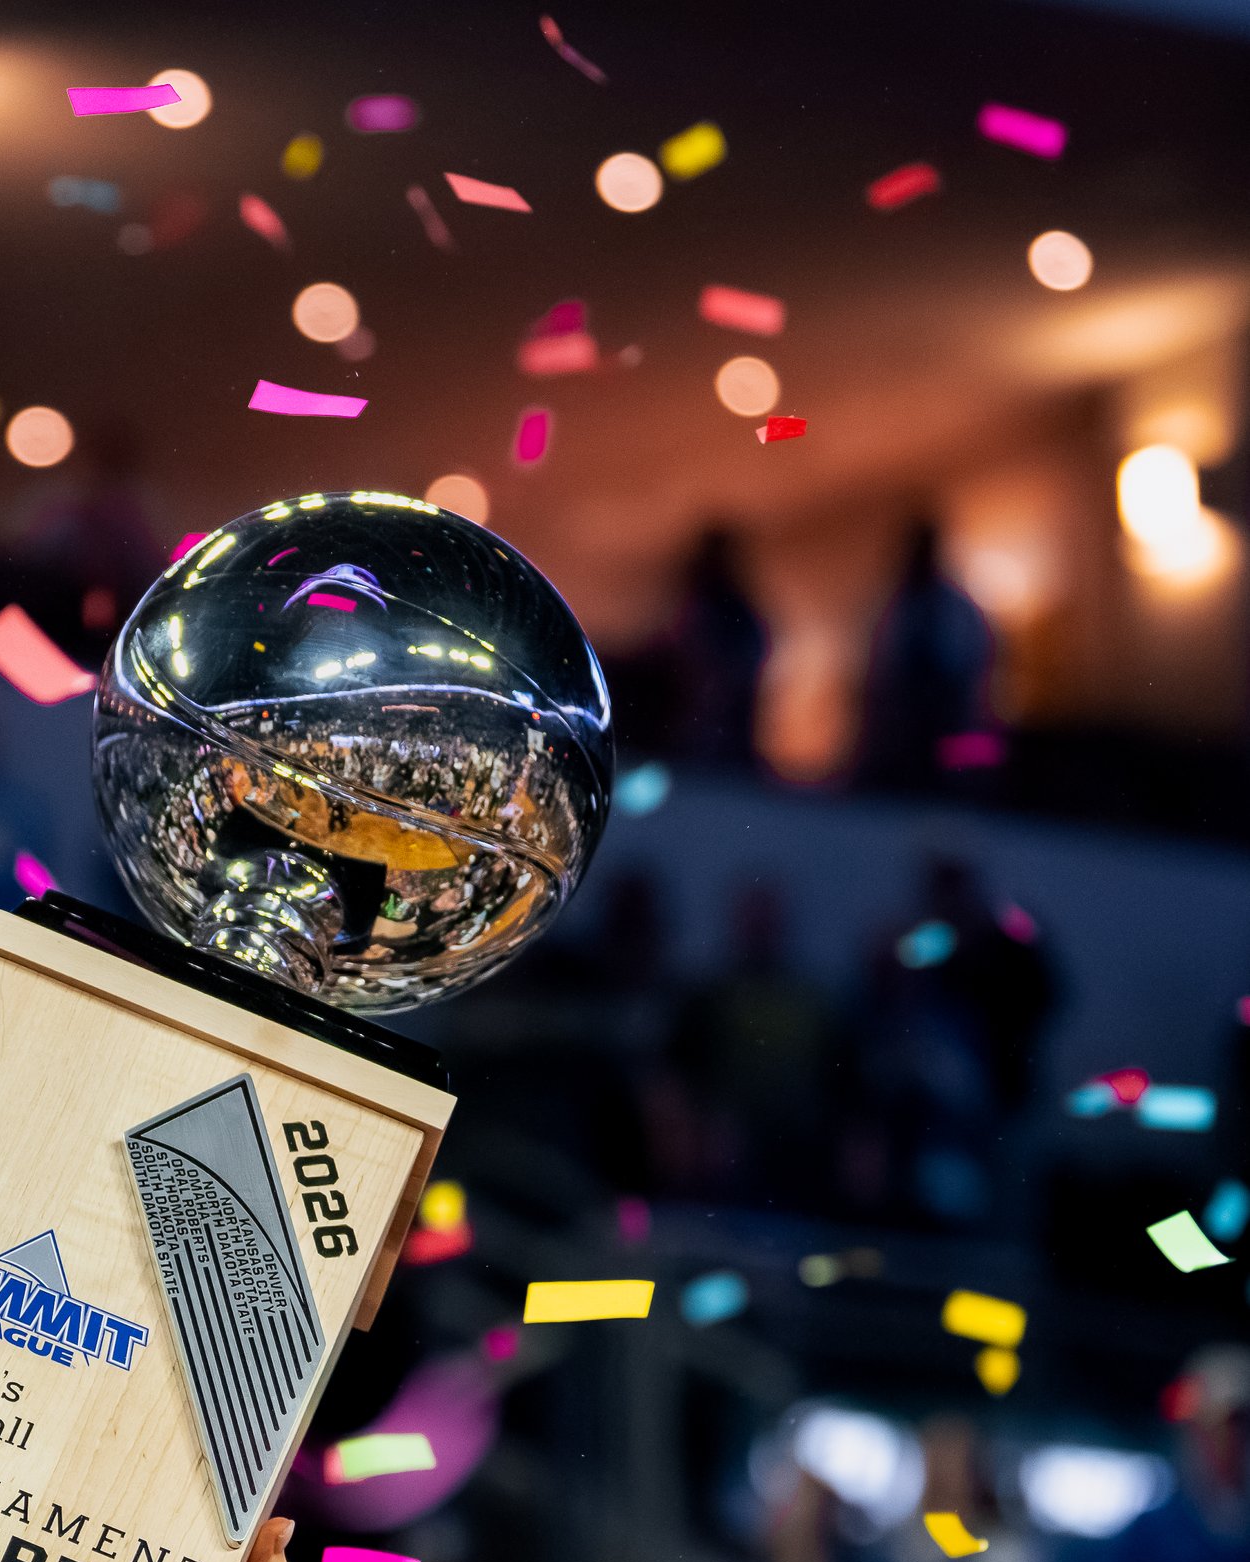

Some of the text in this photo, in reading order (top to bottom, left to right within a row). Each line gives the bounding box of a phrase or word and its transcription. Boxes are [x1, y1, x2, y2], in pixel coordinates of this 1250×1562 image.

[128, 1141, 180, 1295] SOUTH DAKOTA STATE
[141, 1145, 180, 1252] SOUTH DAKOTA
[156, 1151, 189, 1236] ST. THOMAS
[171, 1158, 210, 1264] ORAL ROBERTS
[187, 1169, 210, 1221] OMAHA
[282, 1119, 359, 1258] 2026
[202, 1180, 255, 1335] NORTH DAKOTA STATE
[220, 1197, 259, 1304] NORTH DAKOTA
[239, 1218, 276, 1314] KANSAS CITY
[262, 1253, 287, 1308] DENVER
